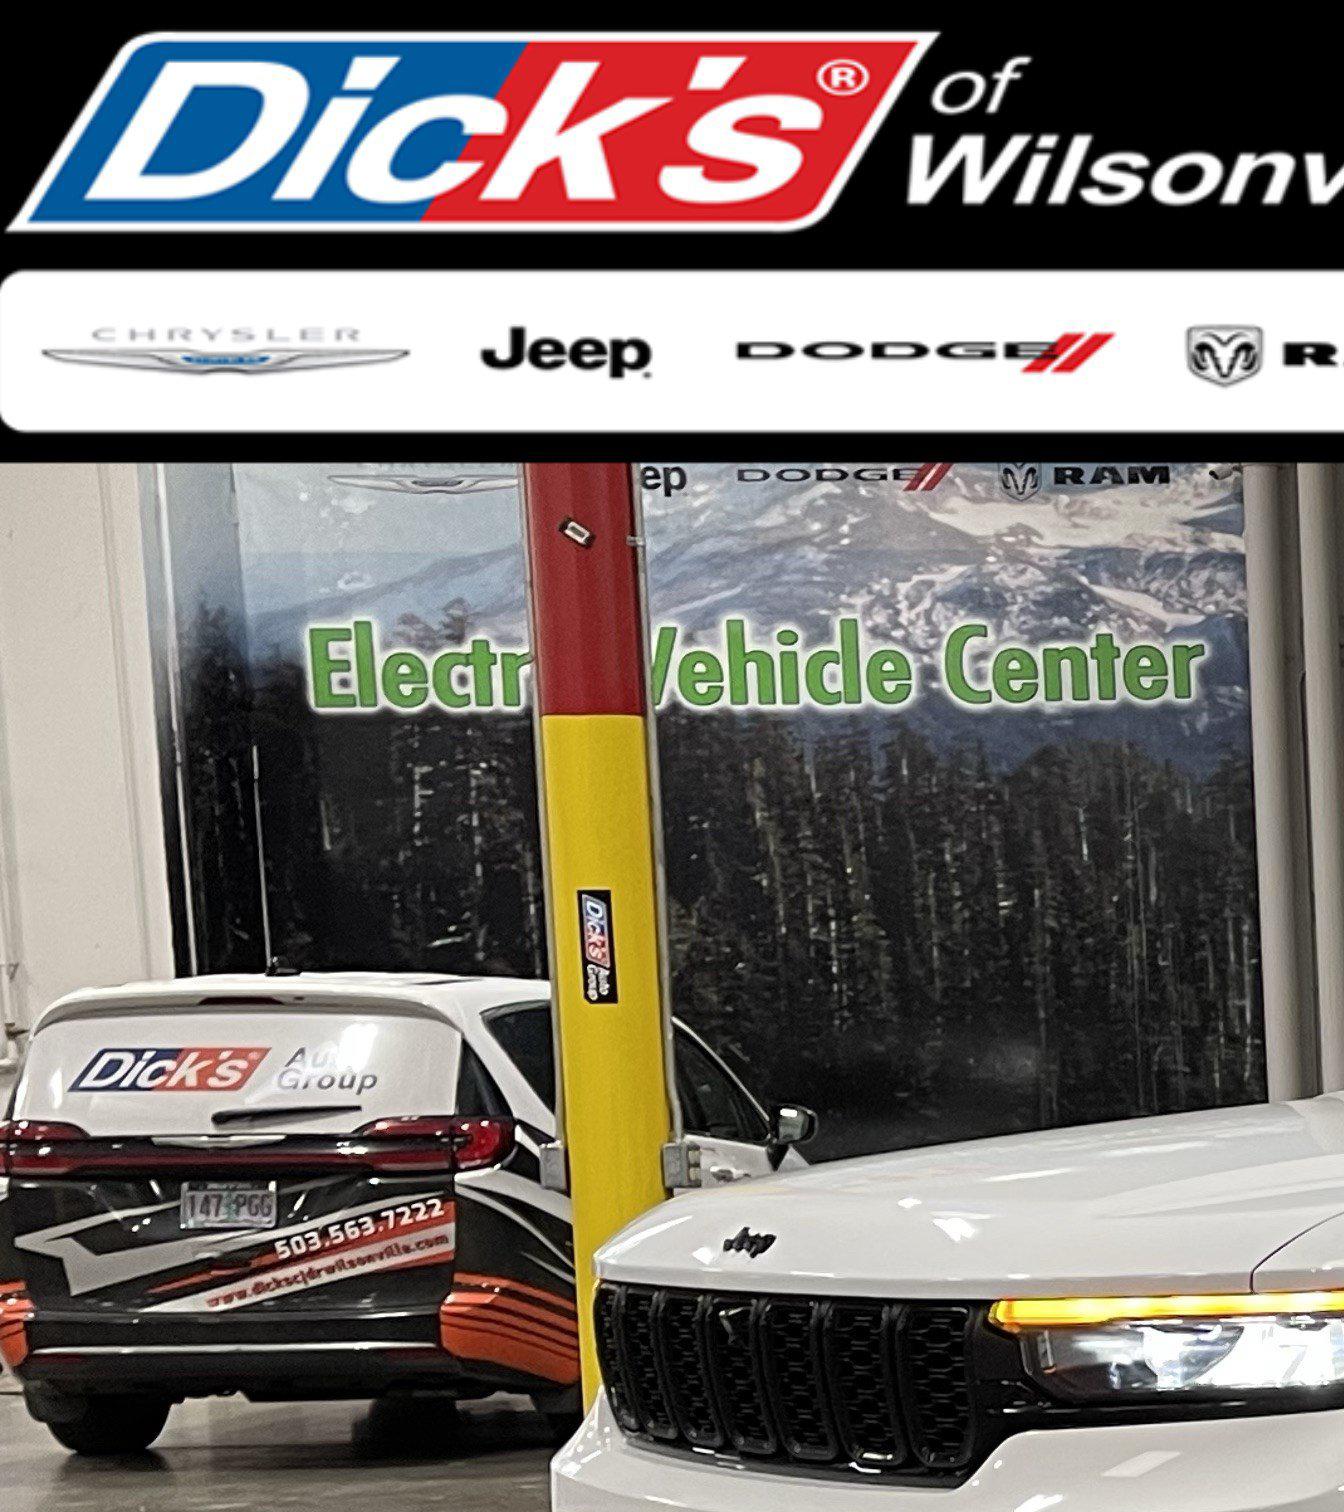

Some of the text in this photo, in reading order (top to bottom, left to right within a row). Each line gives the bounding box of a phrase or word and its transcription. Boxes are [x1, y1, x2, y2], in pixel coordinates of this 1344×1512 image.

[640, 465, 687, 497] ep
[737, 468, 921, 482] DODGE
[1054, 466, 1170, 485] RAM
[308, 619, 537, 707] Electr
[944, 623, 1205, 703] Center
[277, 1067, 378, 1096] Group
[273, 1198, 445, 1261] 503.563.7222
